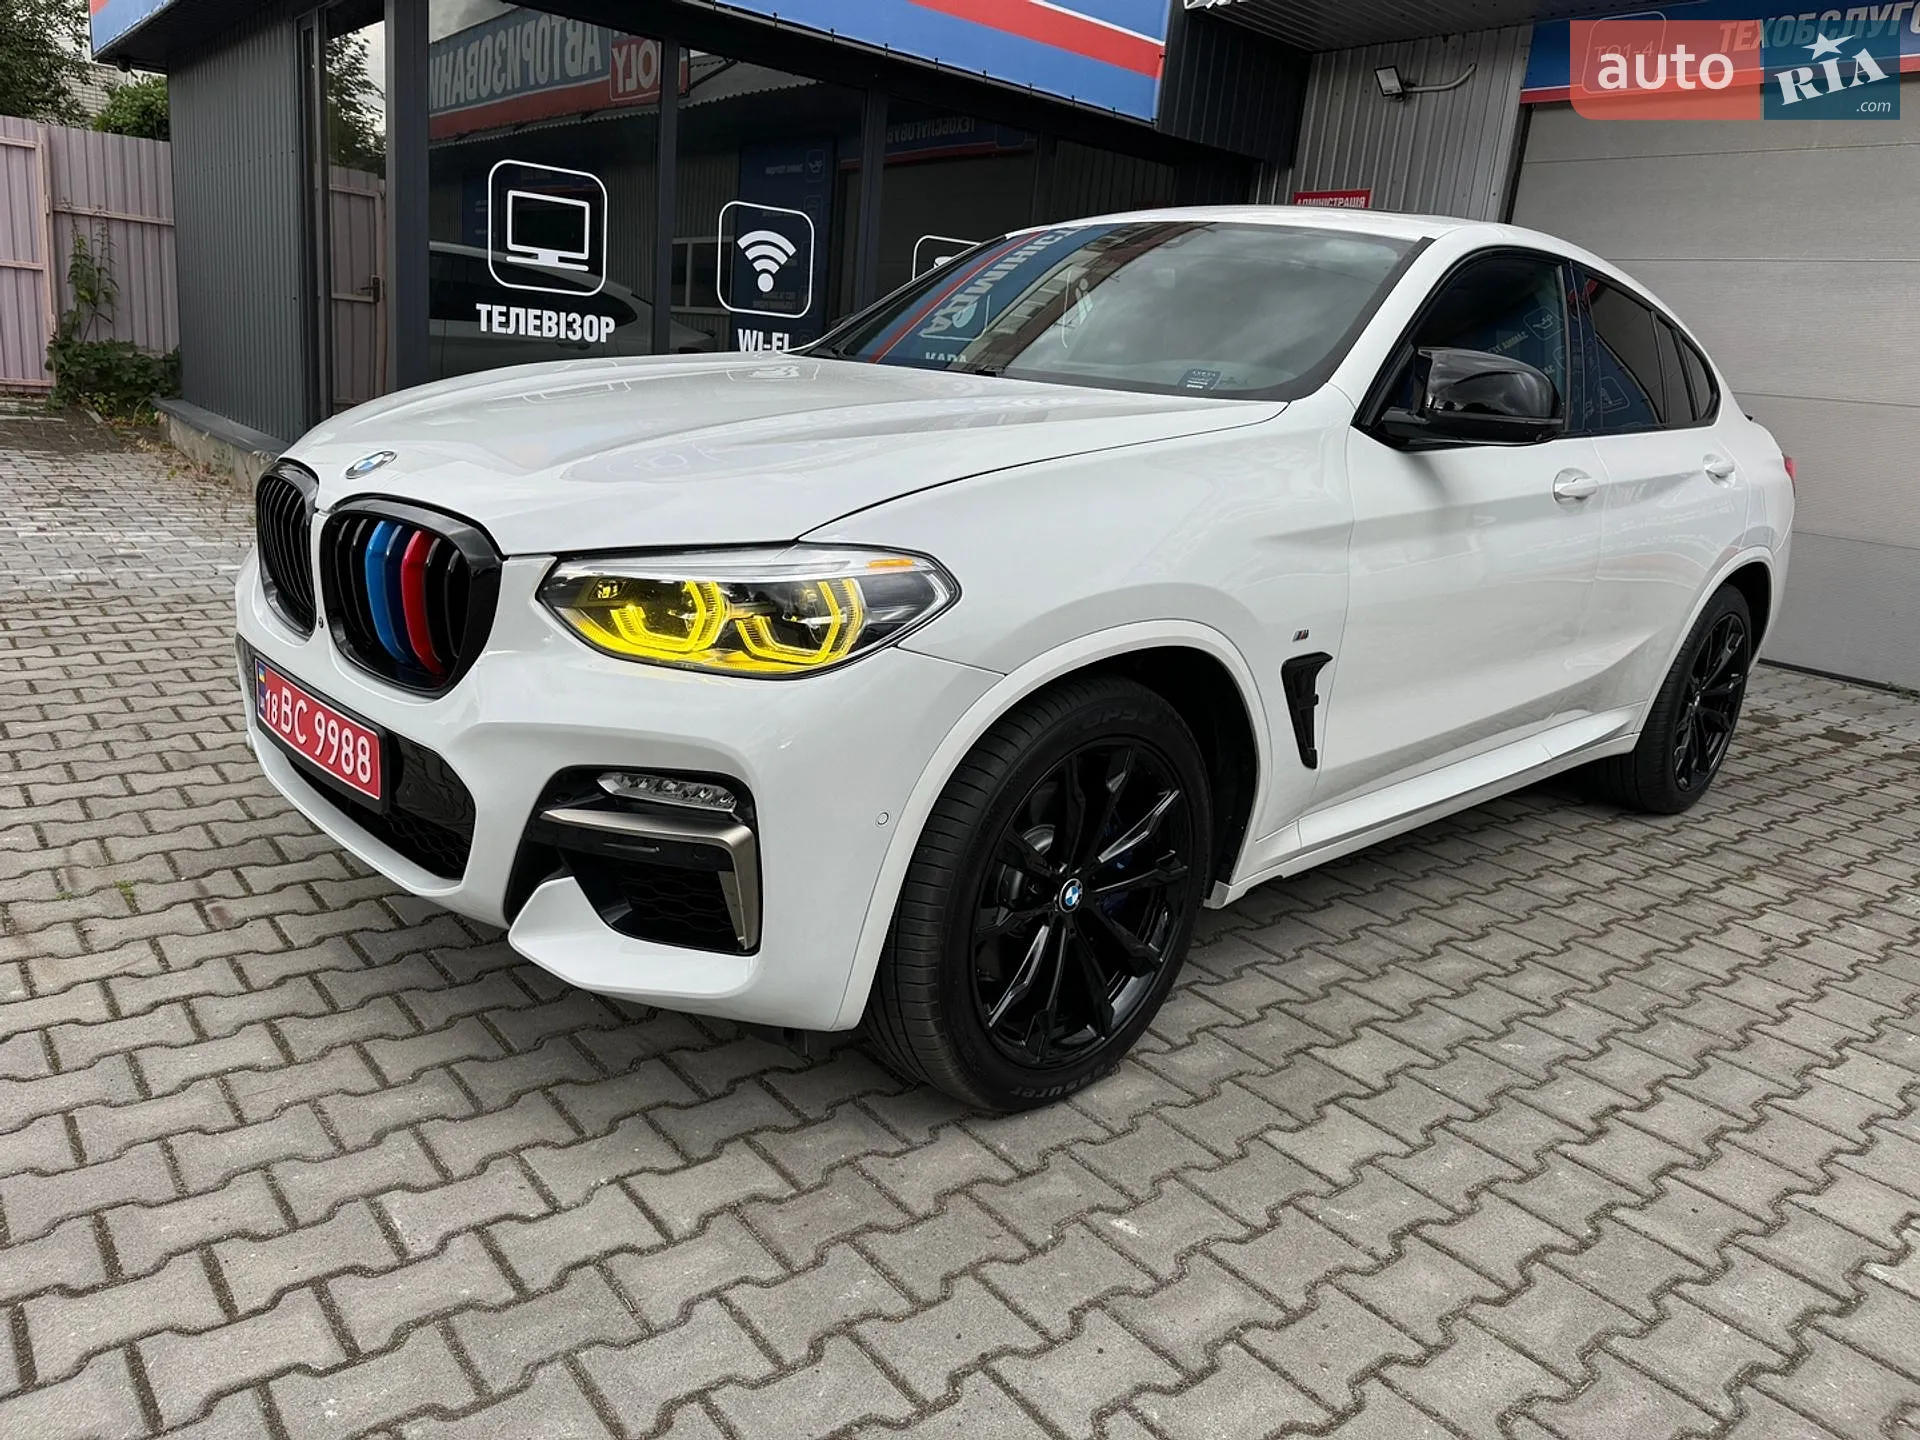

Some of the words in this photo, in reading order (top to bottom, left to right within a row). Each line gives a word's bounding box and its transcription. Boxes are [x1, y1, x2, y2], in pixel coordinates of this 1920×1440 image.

[476, 303, 616, 343] ТЕЛЕВІЗОР
[738, 328, 790, 351] WI-FI
[266, 689, 279, 725] 18
[281, 686, 308, 744] BC
[314, 711, 371, 783] 9988
